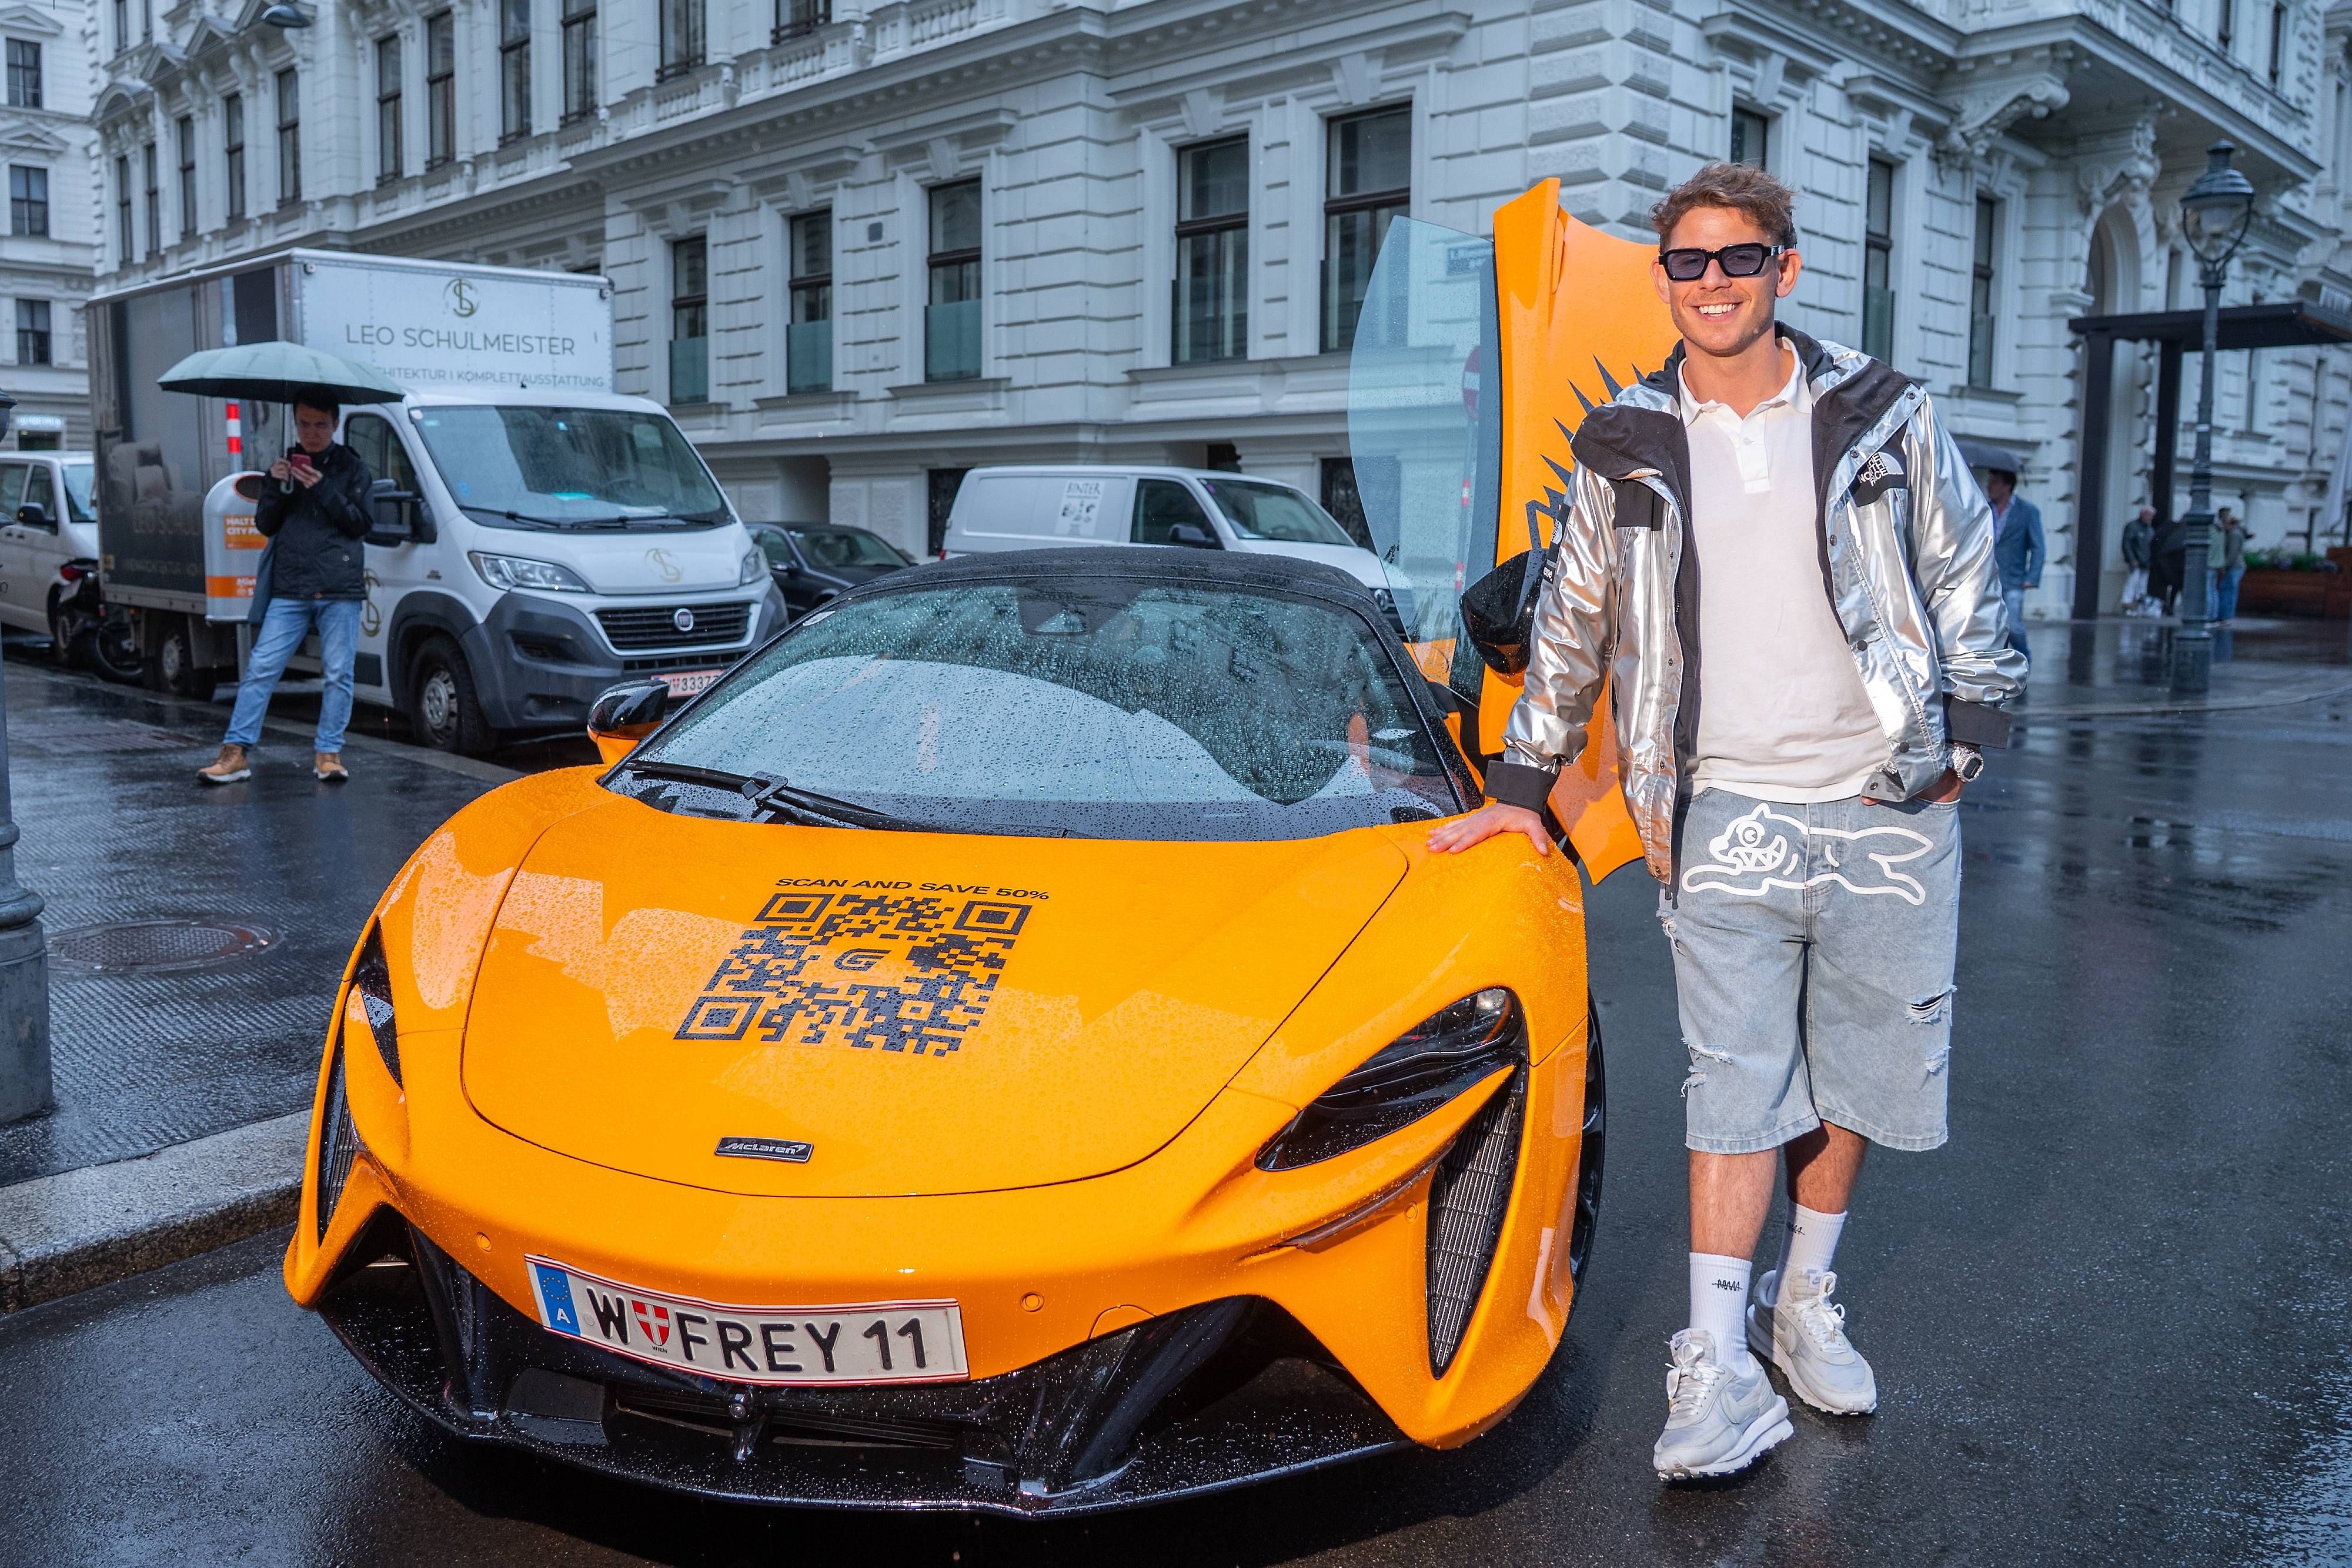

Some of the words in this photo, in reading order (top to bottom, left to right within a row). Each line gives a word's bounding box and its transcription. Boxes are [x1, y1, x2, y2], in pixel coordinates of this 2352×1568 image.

[346, 324, 395, 346] LEO
[403, 327, 576, 356] SCHULMEISTER
[376, 366, 446, 380] HITEKTUR
[457, 370, 605, 387] KOMPLETTAUSSTATTUNG
[226, 527, 248, 535] CITY
[775, 878, 848, 887] SCAN
[851, 880, 913, 890] AND
[918, 882, 990, 895] SAVE
[995, 888, 1050, 900] 50%
[724, 1142, 796, 1154] McLaren
[557, 1308, 571, 1324] A
[586, 1285, 630, 1345] W
[675, 1311, 842, 1373] FREY
[862, 1317, 927, 1371] 11
[652, 1345, 668, 1353] WIEN
